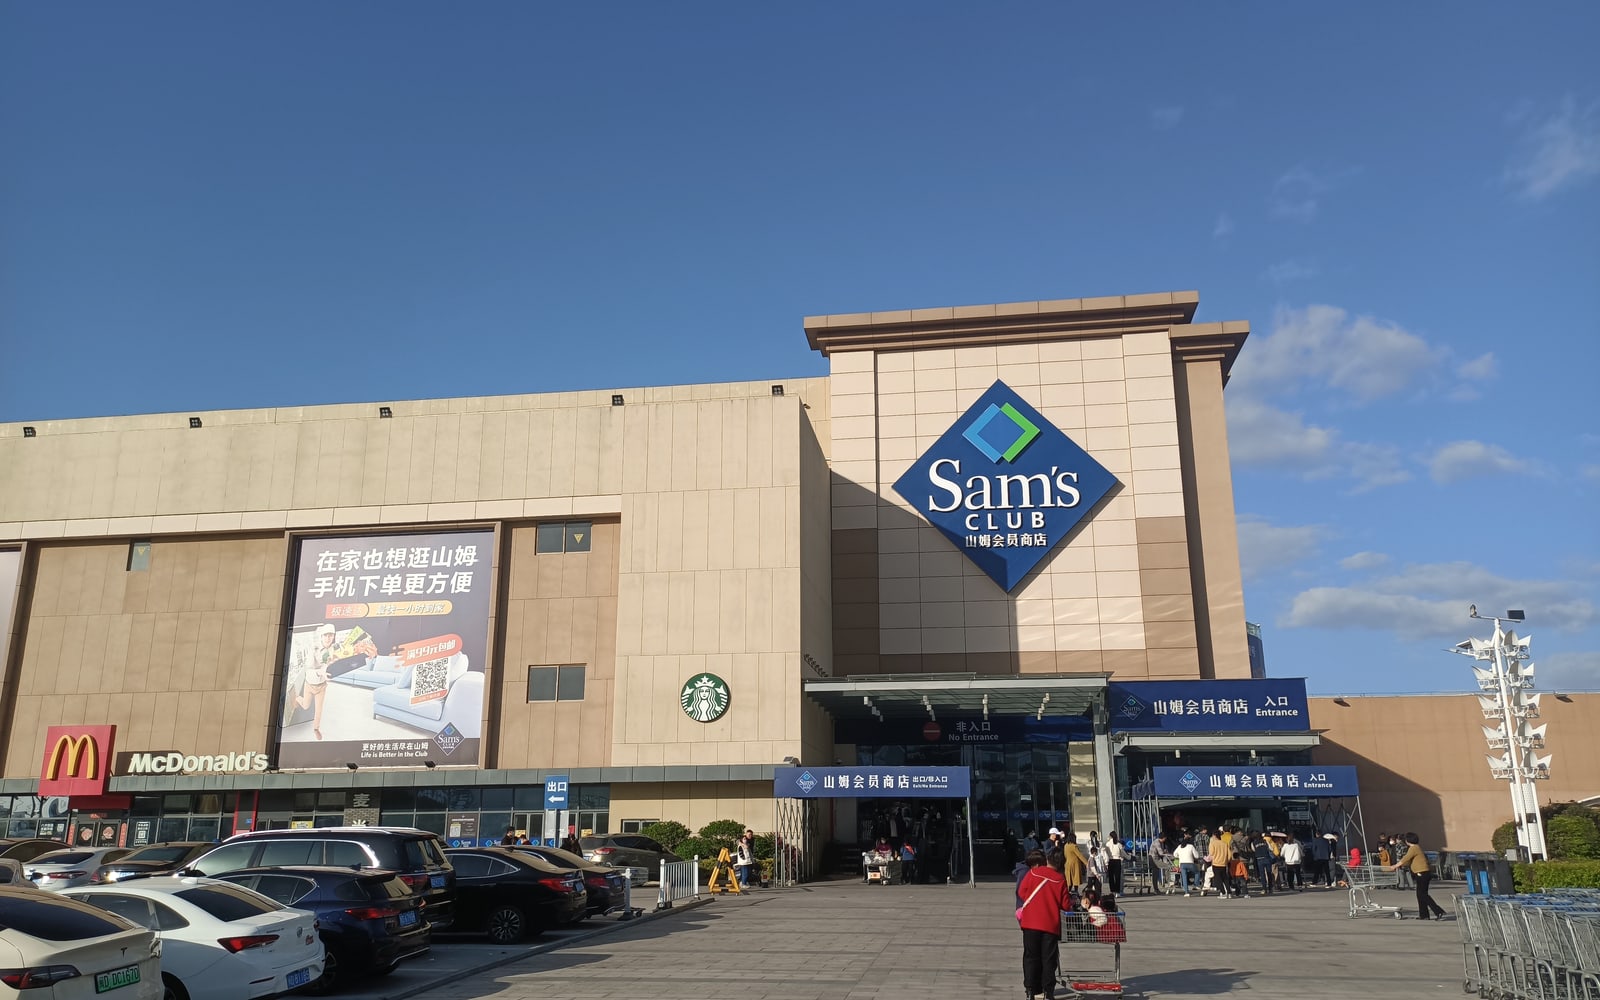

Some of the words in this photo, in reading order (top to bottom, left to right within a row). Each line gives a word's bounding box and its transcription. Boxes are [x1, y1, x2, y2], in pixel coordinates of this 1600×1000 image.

[928, 458, 1080, 512] Sam's
[965, 512, 1045, 531] CLUB
[965, 533, 1047, 548] 山姆会员商店
[316, 544, 480, 573] 在家也想逛山姆
[307, 571, 474, 598] 手机下单更方便
[1153, 699, 1249, 715] 山姆会员商店
[1264, 695, 1288, 707] 入口
[1255, 708, 1298, 717] Entrance
[956, 721, 991, 732] 非入口
[963, 733, 999, 741] Entrance
[127, 751, 269, 774] McDonald's
[823, 774, 909, 789] 山姆会员商店
[1209, 774, 1299, 788] 山姆会员商店
[1309, 773, 1326, 781] 入口
[547, 781, 567, 792] 出口
